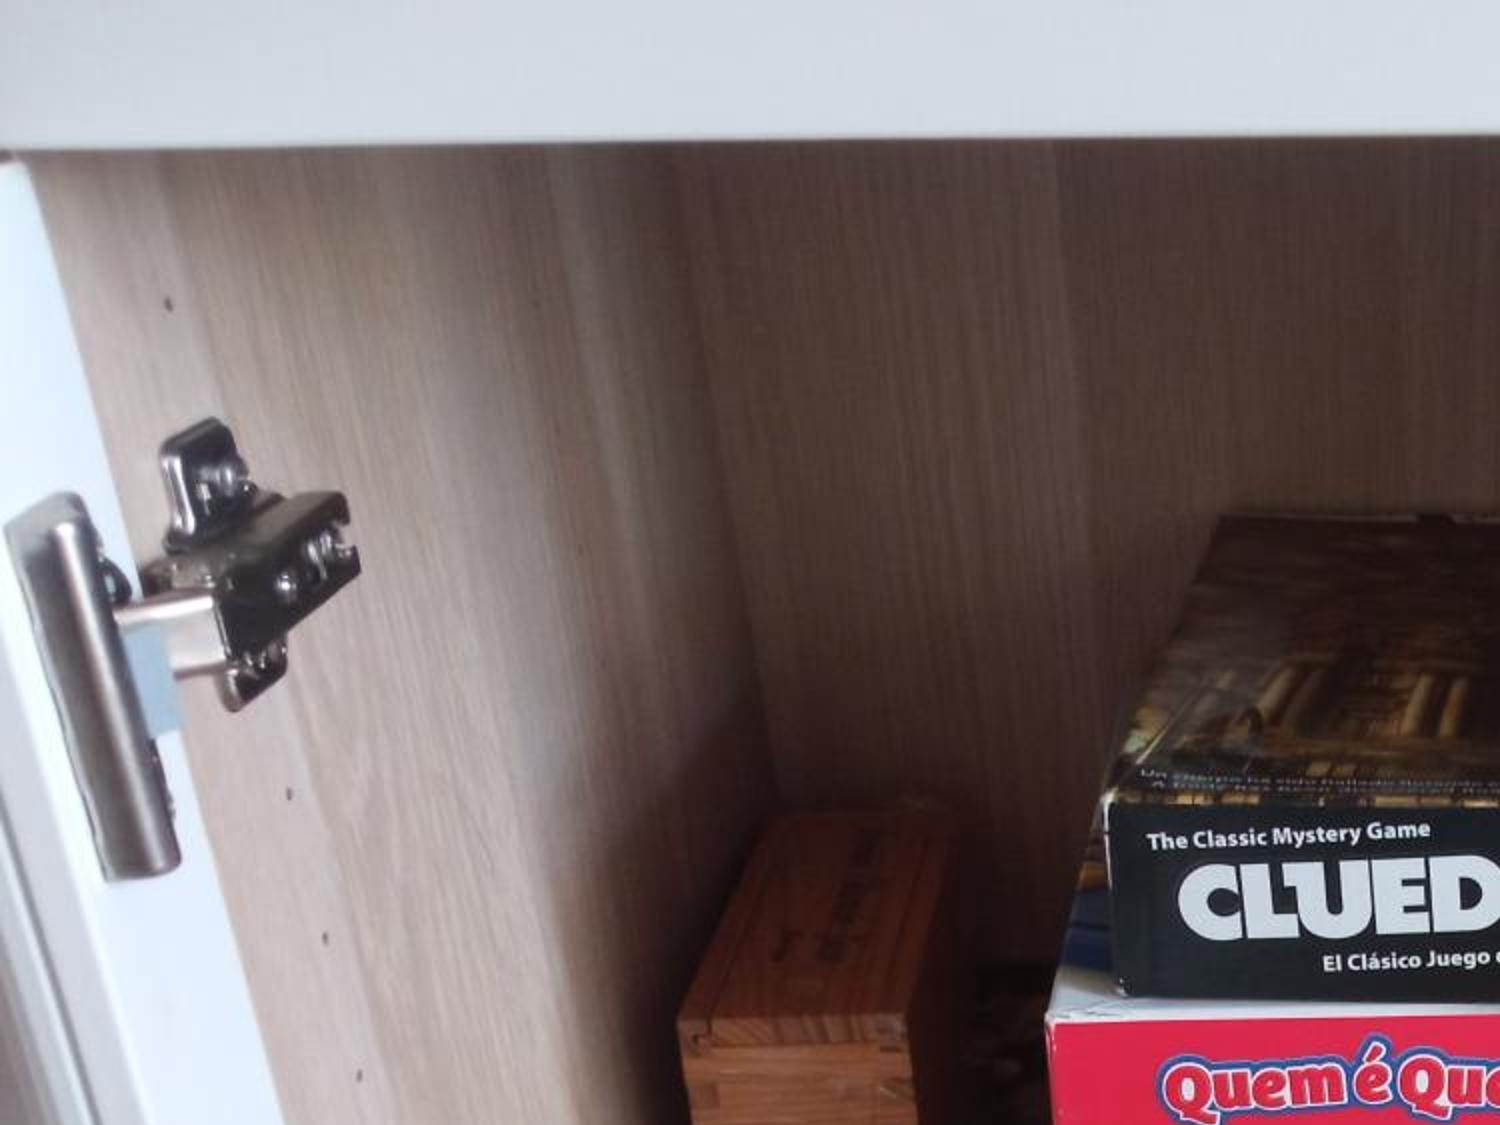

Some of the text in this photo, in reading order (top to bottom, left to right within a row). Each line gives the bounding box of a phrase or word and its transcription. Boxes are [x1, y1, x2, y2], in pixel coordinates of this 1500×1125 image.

[1146, 821, 1432, 850] The Classic Mystery Game
[1322, 954, 1343, 972] El
[1348, 951, 1422, 972] Clásico
[1426, 949, 1491, 971] Juego
[1353, 1040, 1393, 1106] é
